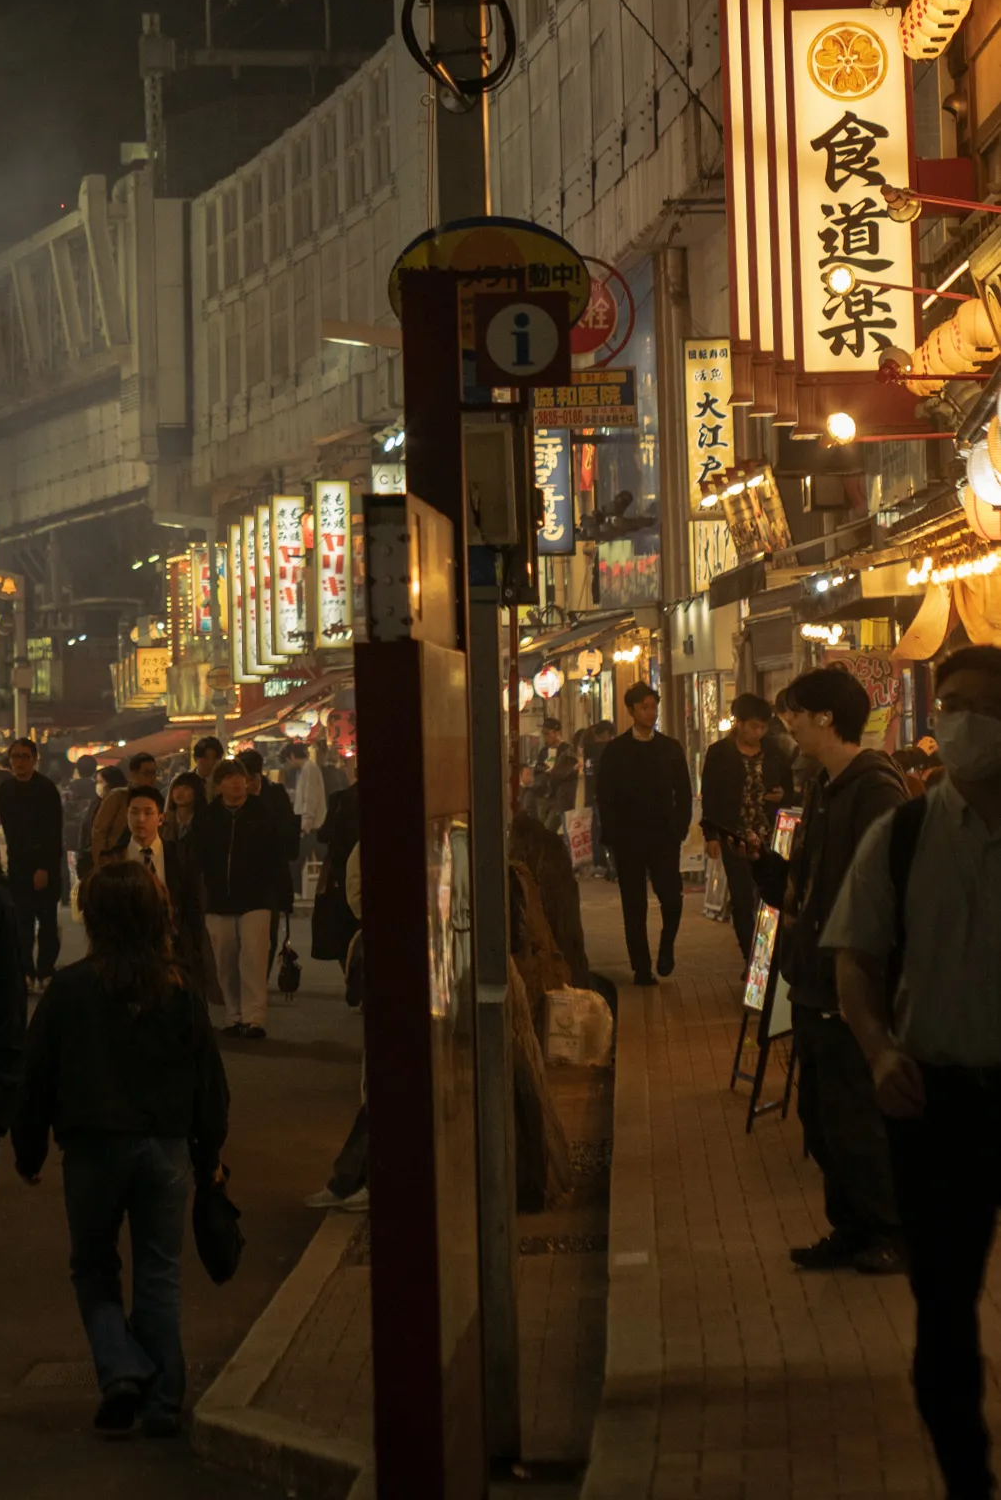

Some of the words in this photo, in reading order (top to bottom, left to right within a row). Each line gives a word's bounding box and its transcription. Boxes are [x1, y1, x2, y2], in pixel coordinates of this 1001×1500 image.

[810, 110, 898, 358] 食道楽
[693, 392, 730, 486] 大江戸
